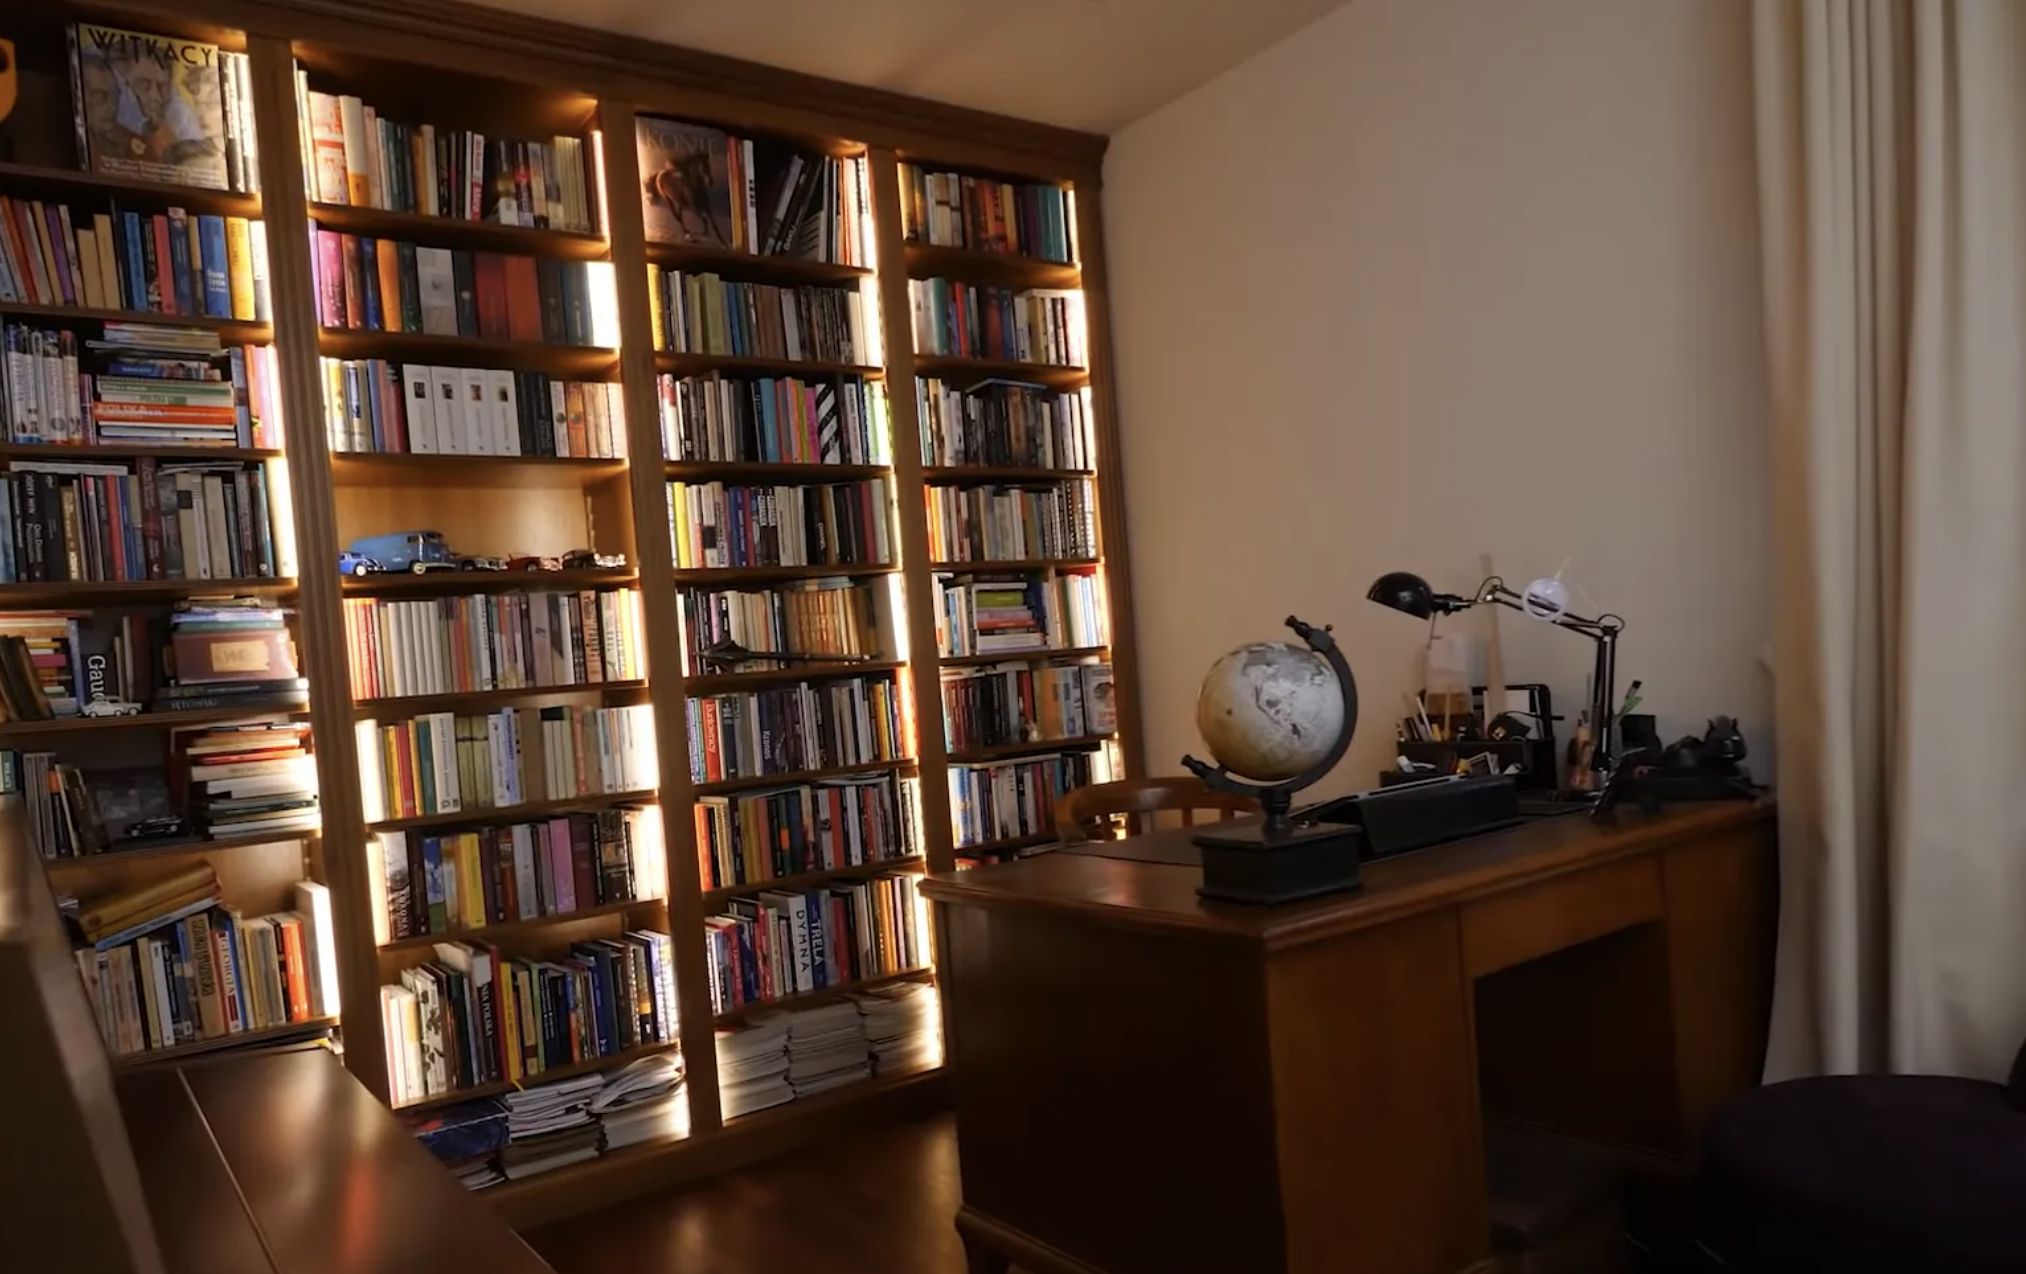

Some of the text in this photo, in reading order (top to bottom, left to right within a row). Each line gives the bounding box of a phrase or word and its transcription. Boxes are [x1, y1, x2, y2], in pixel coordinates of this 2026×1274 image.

[88, 28, 213, 70] WITKACY
[796, 909, 813, 973] DYMNA
[810, 918, 826, 967] TRELA
[483, 999, 494, 1037] POLSKA
